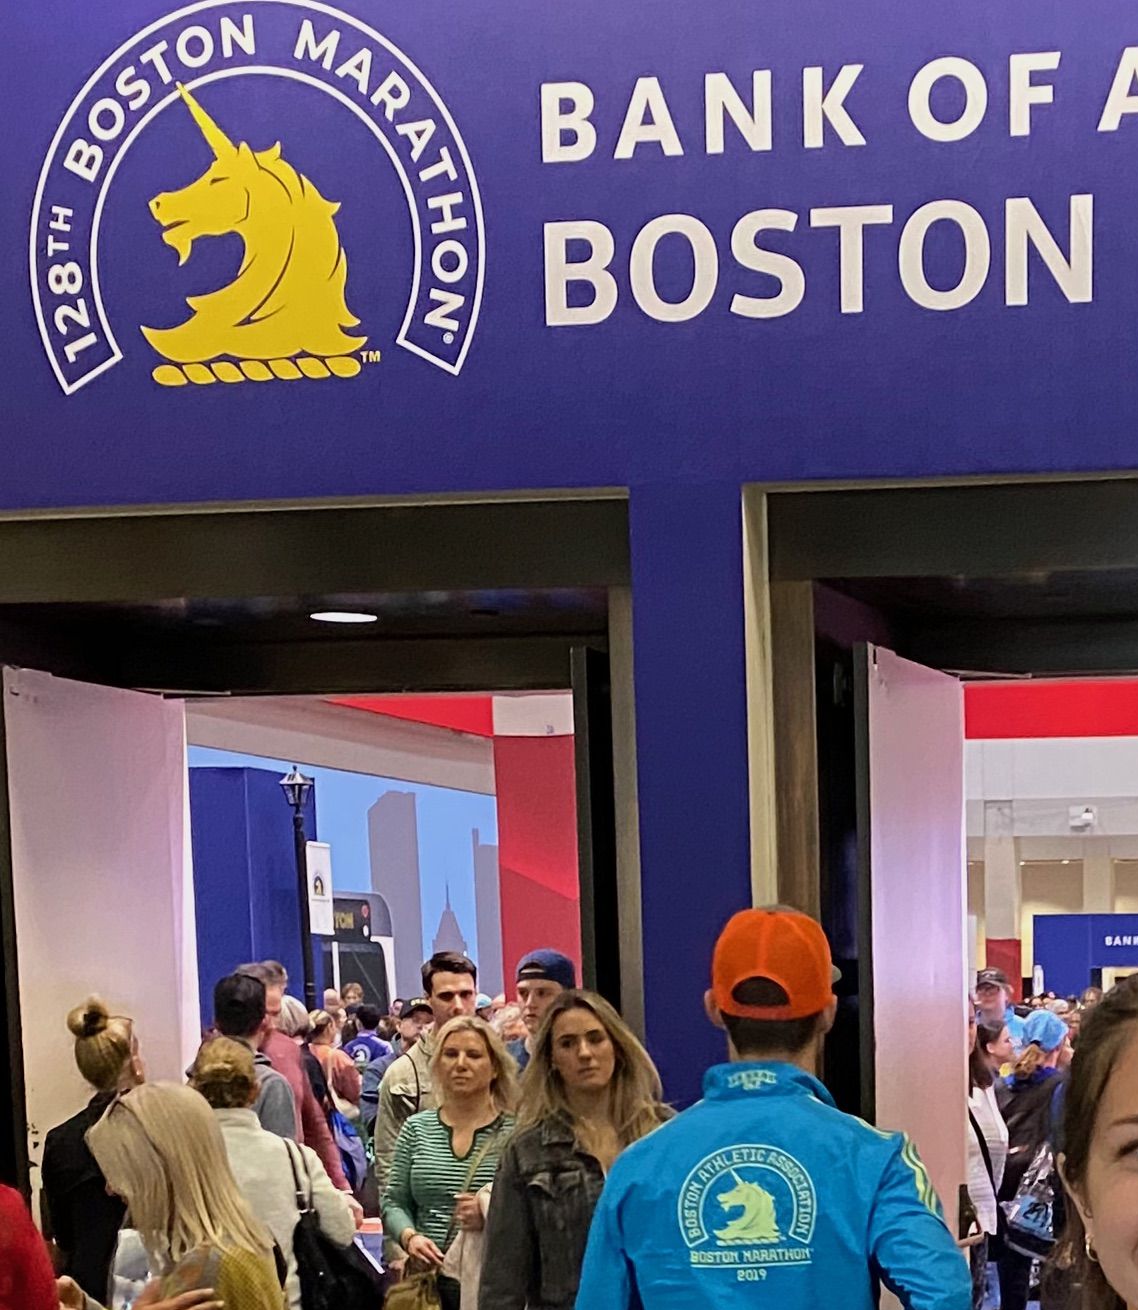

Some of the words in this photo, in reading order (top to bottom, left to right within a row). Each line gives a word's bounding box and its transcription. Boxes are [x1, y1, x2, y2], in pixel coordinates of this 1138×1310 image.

[63, 14, 256, 182] BOSTON
[540, 64, 867, 163] BANK
[908, 51, 1061, 142] OF
[48, 205, 98, 363] 128TH
[543, 194, 1093, 327] BOSTON
[684, 1181, 703, 1238] BOSTON
[698, 1149, 766, 1182] ATHLETIC
[767, 1151, 812, 1235] ASSOCIATION
[690, 1250, 740, 1263] BOSTON
[742, 1248, 811, 1261] MARATHON
[736, 1268, 767, 1281] 2019
